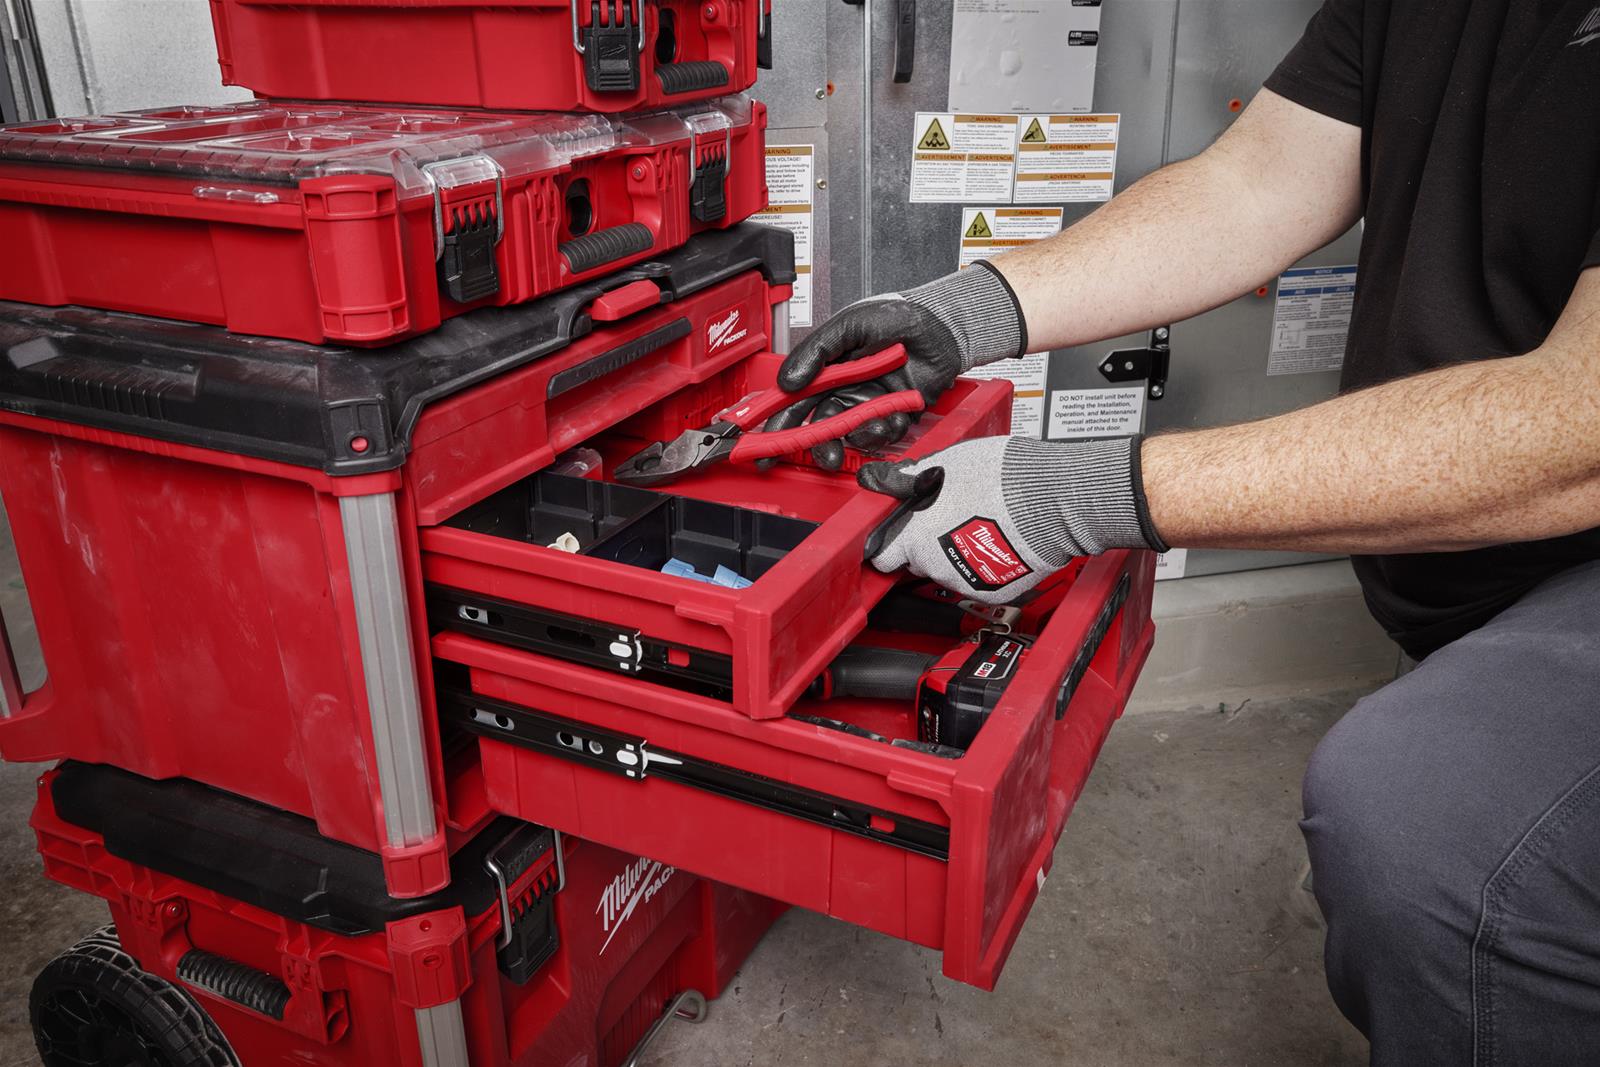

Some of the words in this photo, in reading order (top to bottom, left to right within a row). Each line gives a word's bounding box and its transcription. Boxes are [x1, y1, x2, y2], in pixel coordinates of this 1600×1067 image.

[707, 309, 740, 346] Milwaukee
[723, 328, 747, 346] PACKOUT
[1055, 411, 1085, 419] Operation,
[1062, 403, 1085, 411] reading
[972, 524, 1018, 565] Milwaukee
[962, 548, 970, 558] XL
[948, 547, 959, 561] CUT
[957, 560, 972, 578] LEVEL
[977, 663, 993, 677] M18
